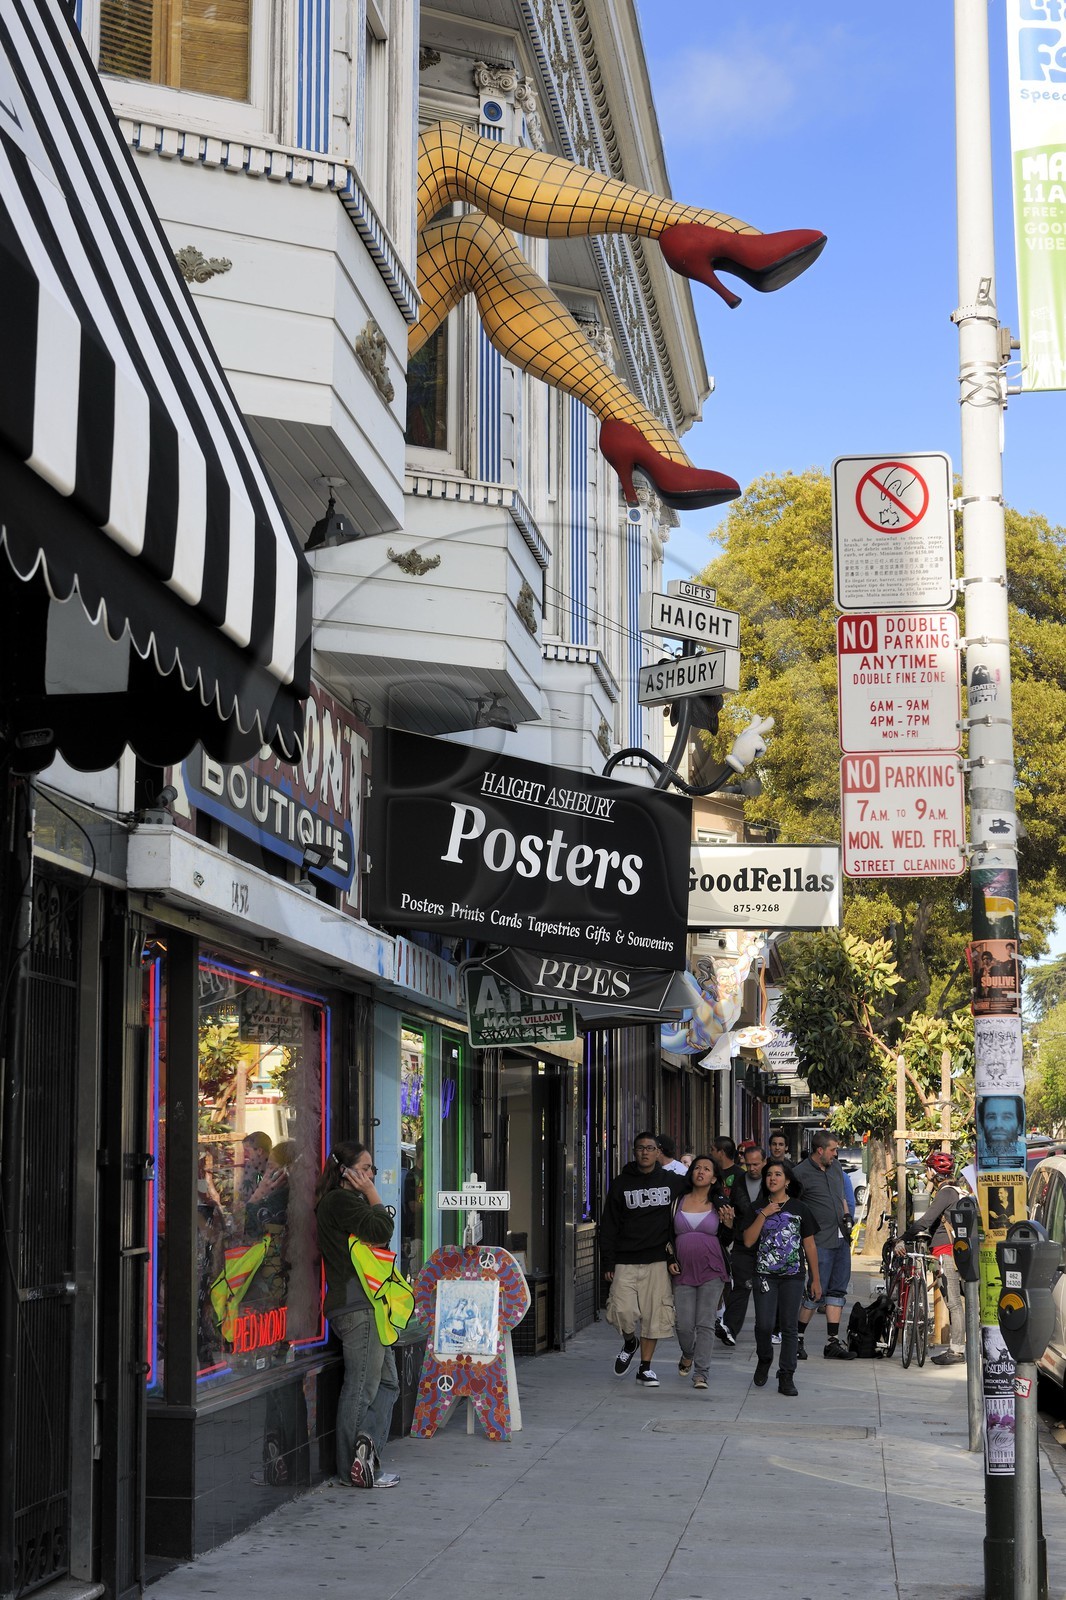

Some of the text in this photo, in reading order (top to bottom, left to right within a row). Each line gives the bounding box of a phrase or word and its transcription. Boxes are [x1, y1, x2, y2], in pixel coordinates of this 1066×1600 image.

[1023, 206, 1057, 217] FREE
[1024, 222, 1066, 234] GOO
[685, 585, 711, 599] GIFTS
[661, 604, 732, 637] HAIGHT
[887, 617, 948, 632] DOUBLE
[843, 620, 873, 649] NO
[885, 634, 949, 649] PARKING
[860, 655, 938, 670] ANYTIME
[646, 661, 717, 693] ASHBURY
[854, 672, 945, 684] DOUBLE FINE ZONE
[870, 700, 893, 712] 6AM
[907, 700, 929, 710] 9AM
[870, 716, 894, 727] 4PM
[907, 715, 930, 726] 7PM
[847, 759, 875, 788] NO
[886, 765, 954, 788] PARKING
[481, 772, 616, 818] HAIGHT ASHBURY
[849, 830, 959, 849] MON. WED. FRI.
[440, 802, 643, 896] Posters
[854, 859, 956, 872] STREET CLEANING
[733, 904, 780, 913] 875-9268
[401, 893, 674, 952] Posters Prints Cards Tapestries Gifts & Souvenirs
[534, 958, 631, 998] PIPES
[981, 976, 1015, 987] SOULIVE
[524, 1014, 562, 1024] VILLANY
[442, 1196, 504, 1206] ASHBURY
[624, 1186, 671, 1209] UCSB
